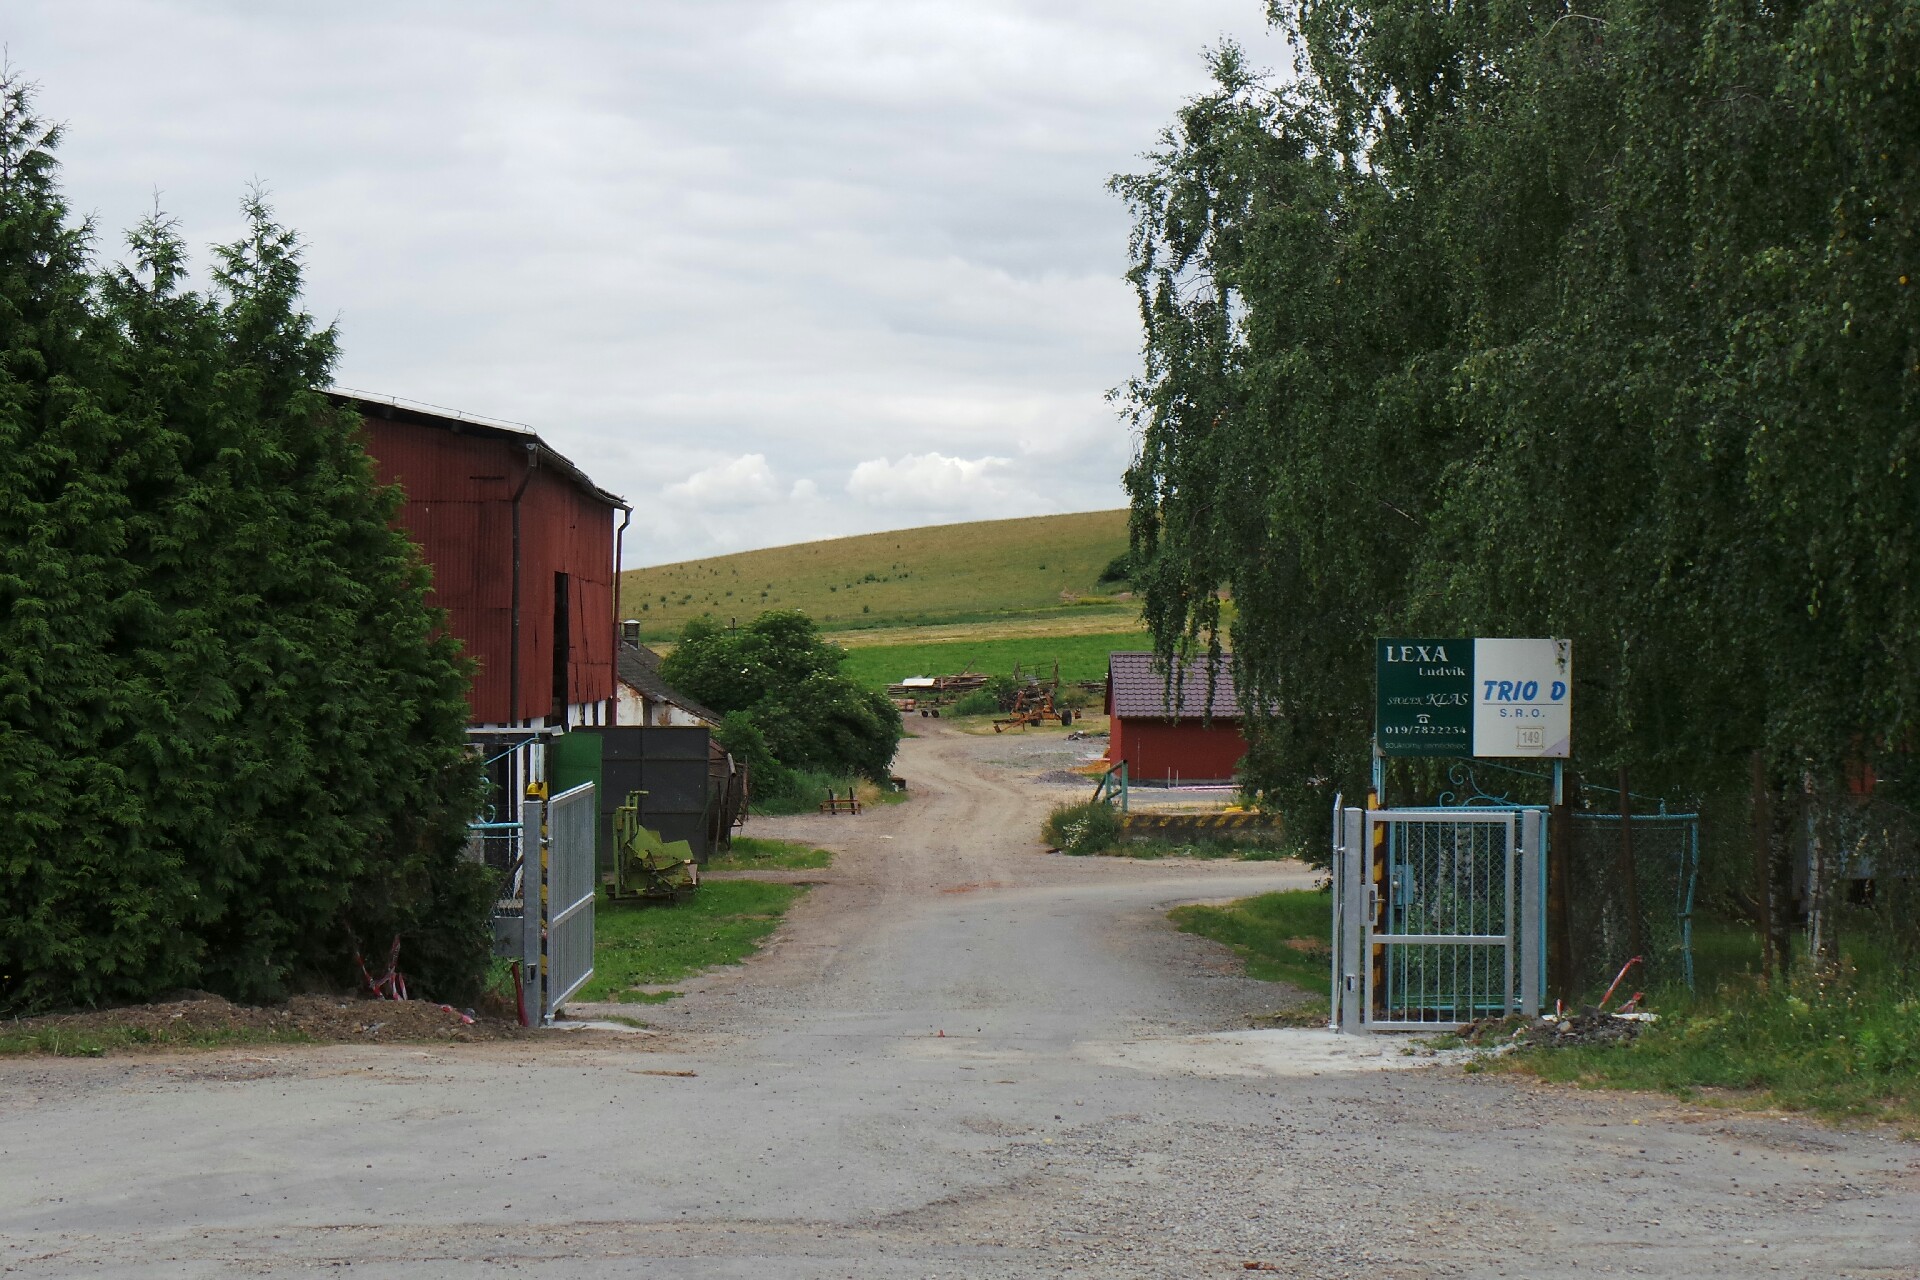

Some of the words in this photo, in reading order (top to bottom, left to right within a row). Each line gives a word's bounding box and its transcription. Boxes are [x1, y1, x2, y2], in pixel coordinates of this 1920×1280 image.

[1386, 645, 1449, 663] LEXA
[1483, 680, 1538, 702] TRIO
[1550, 680, 1566, 702] D
[1425, 693, 1469, 707] KLAS
[1499, 708, 1546, 718] S.R.O.
[1522, 731, 1540, 744] 149
